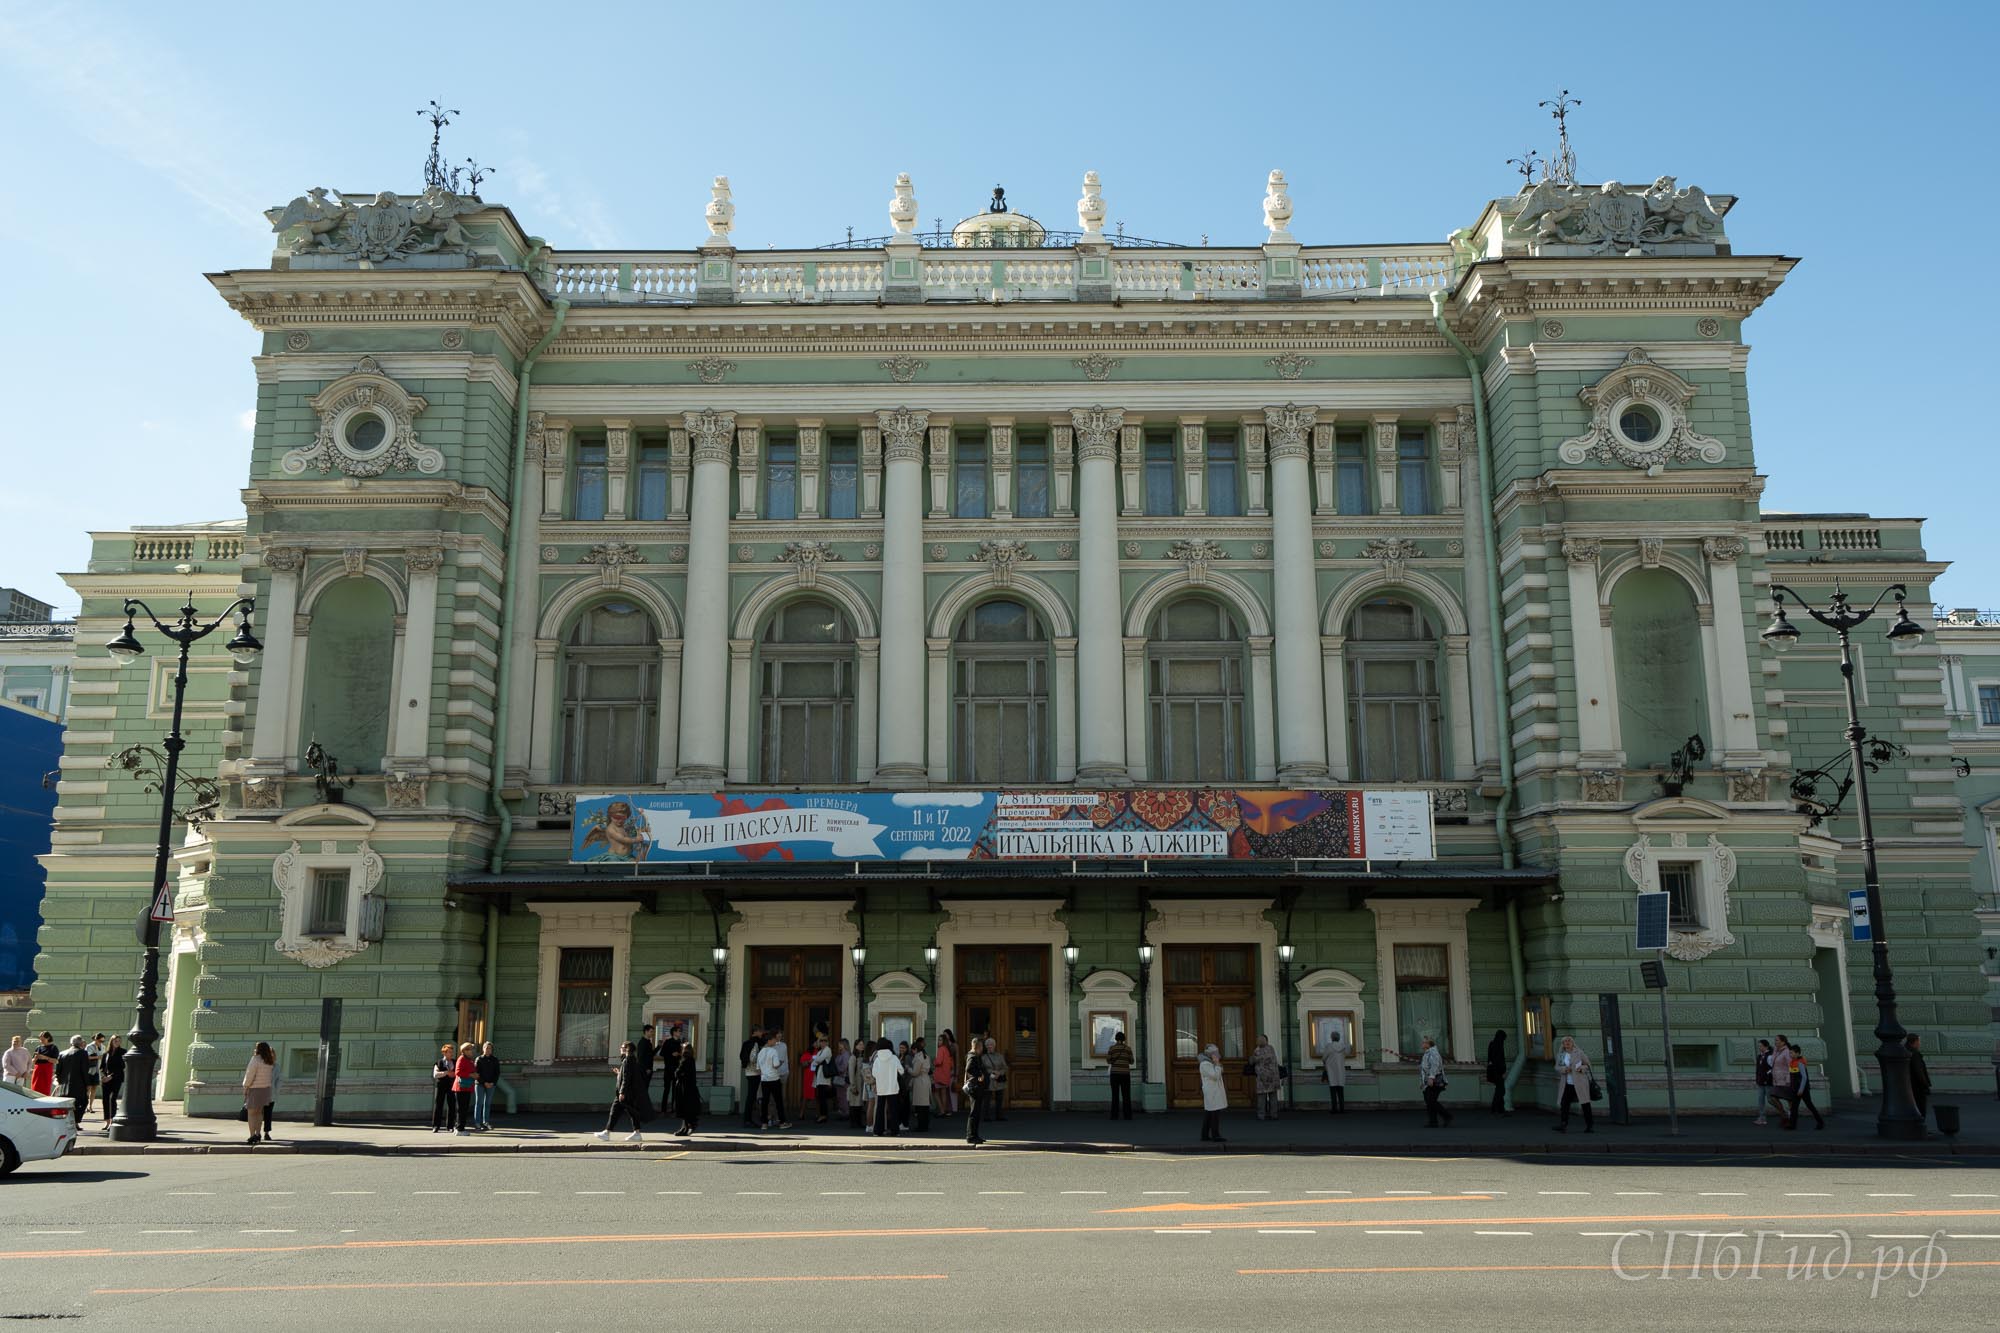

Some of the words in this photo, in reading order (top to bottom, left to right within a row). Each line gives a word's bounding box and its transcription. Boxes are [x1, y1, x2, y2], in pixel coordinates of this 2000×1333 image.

[806, 798, 858, 812] ПРЕМЬЕРА
[1012, 795, 1019, 804] 8
[1033, 795, 1041, 804] 15
[913, 809, 921, 825] 11
[937, 809, 949, 825] 17
[1000, 807, 1045, 816] Премьера
[677, 825, 714, 846] ДОН
[724, 813, 819, 842] ПАСКУАЛЕ
[1352, 797, 1361, 854] MARIINSKY.RU
[890, 830, 935, 842] СЕНТЯБРЯ
[941, 826, 971, 842] 2022
[1000, 834, 1115, 854] ИТАЛЬЯНКА
[1122, 834, 1133, 853] В
[1140, 834, 1223, 853] АЛЖИРЕ
